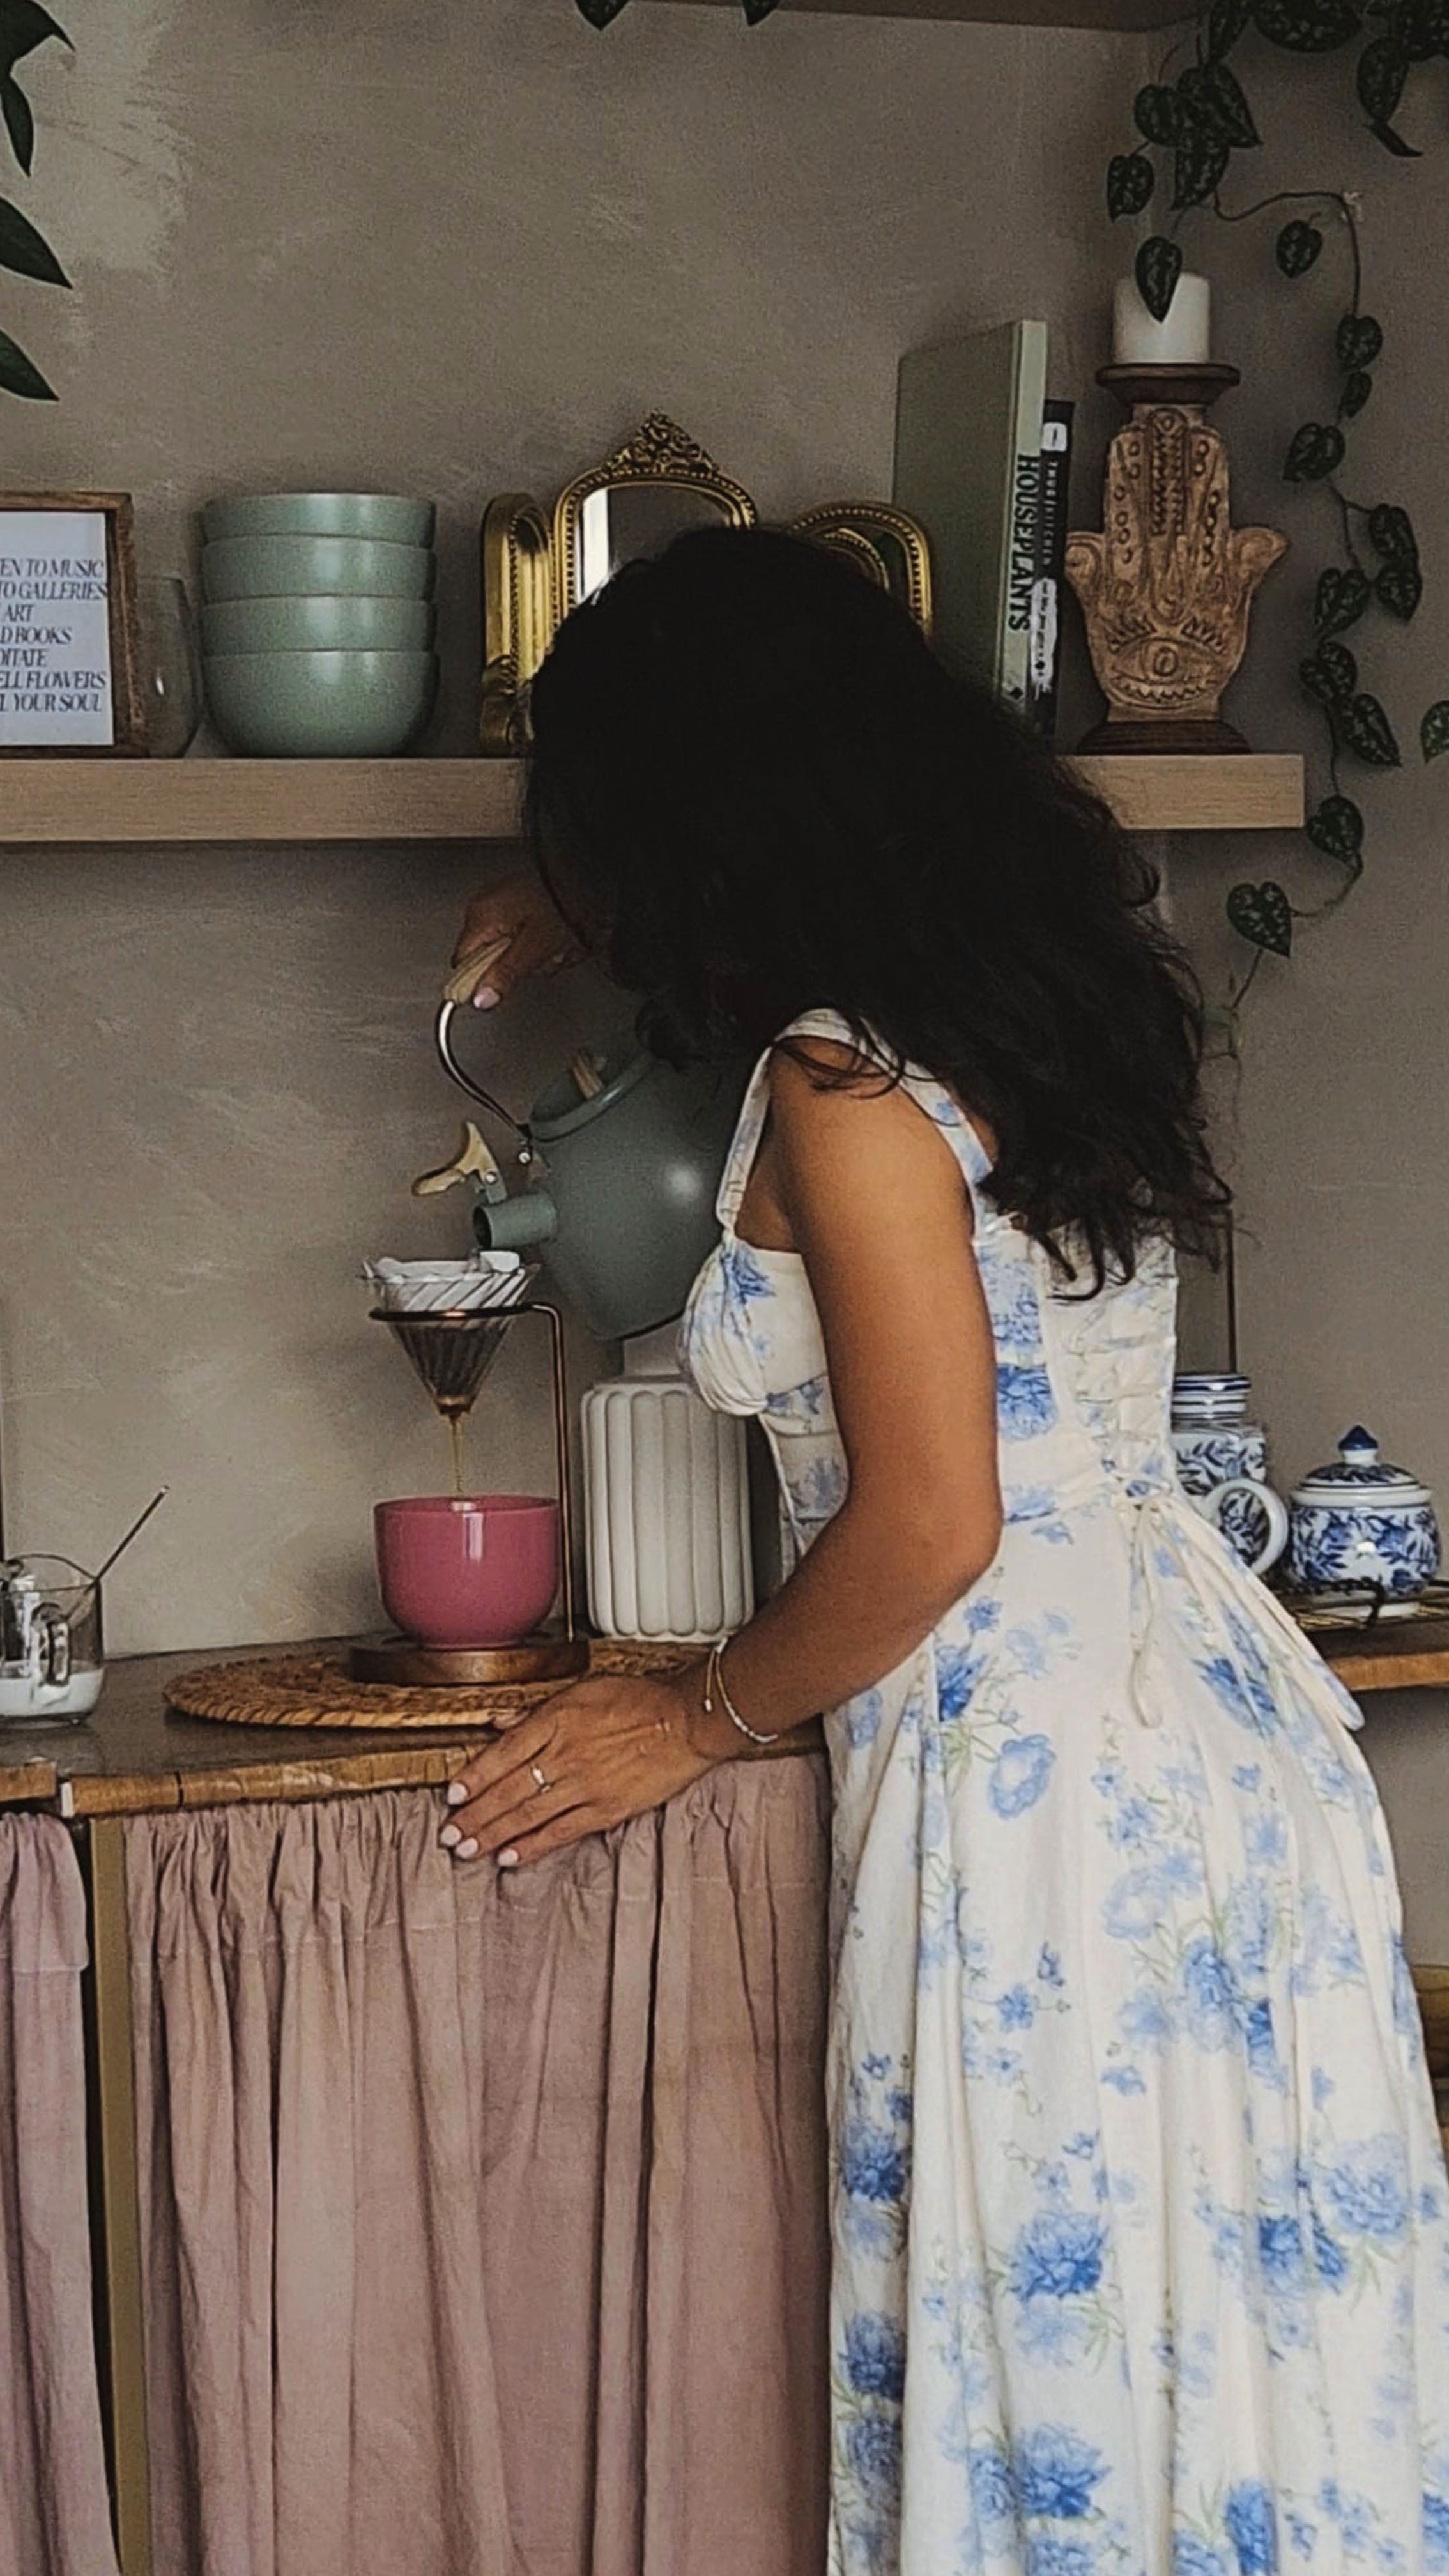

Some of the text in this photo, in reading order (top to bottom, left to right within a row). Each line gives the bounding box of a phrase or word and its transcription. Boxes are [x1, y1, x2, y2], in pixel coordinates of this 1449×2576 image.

[1008, 454, 1040, 631] HOUSEPLANTS
[27, 558, 47, 576] TO
[49, 558, 105, 576] MUSIC
[19, 580, 108, 600] GALLERIES
[3, 603, 35, 622] ART
[15, 625, 73, 645] BOOKS
[26, 671, 106, 689] FLOWERS
[13, 693, 57, 712] YOUR
[58, 693, 102, 713] SOUL
